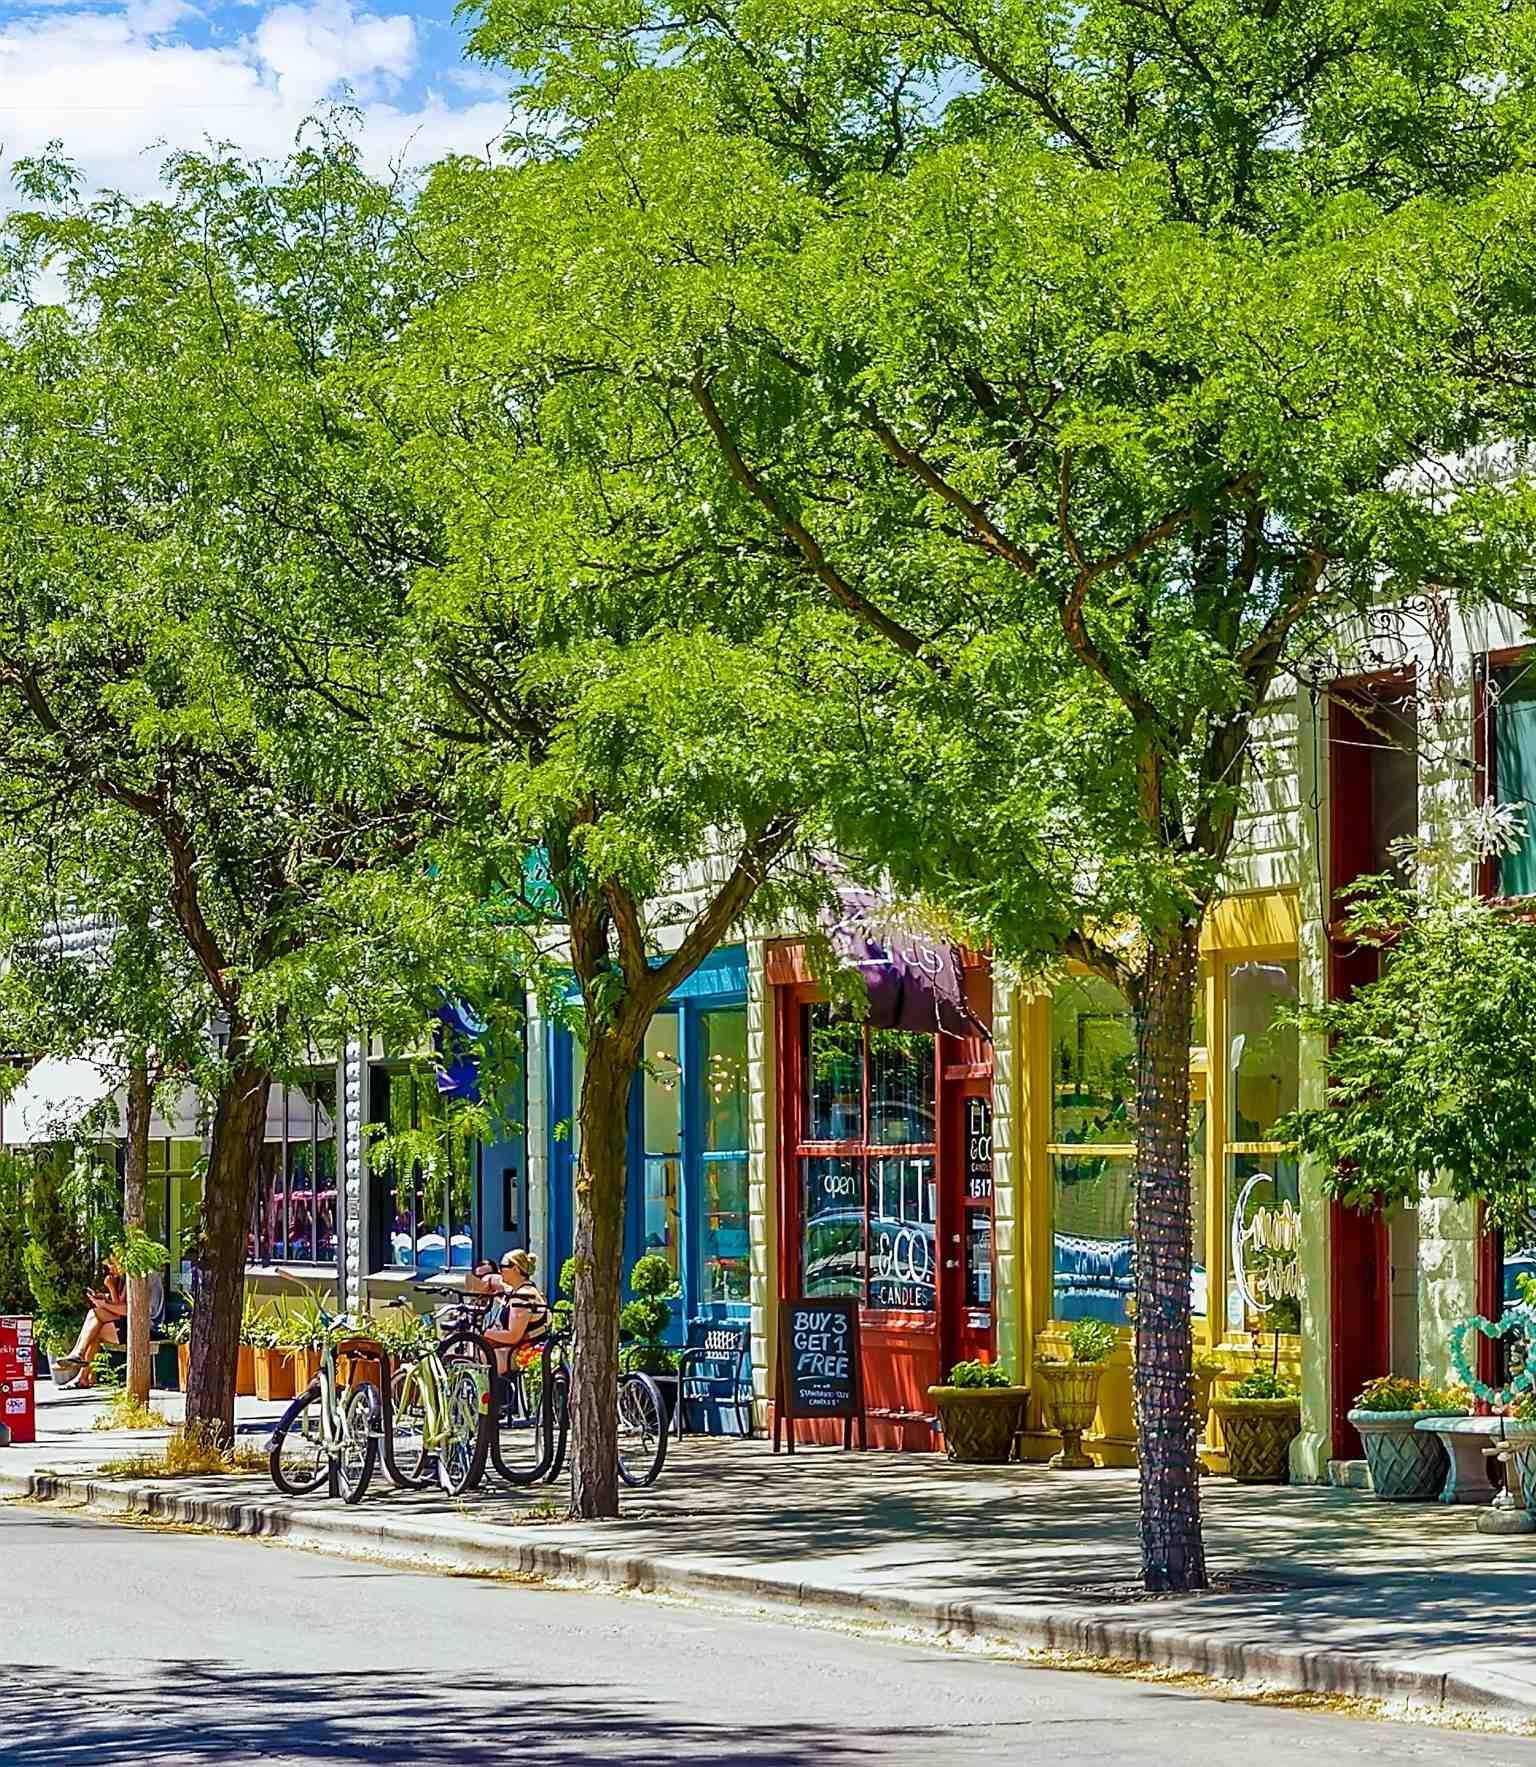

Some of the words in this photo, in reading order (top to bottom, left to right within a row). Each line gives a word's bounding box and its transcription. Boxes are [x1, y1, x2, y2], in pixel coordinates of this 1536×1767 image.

[824, 1175, 855, 1198] open
[879, 1160, 930, 1224] LIT
[969, 1178, 992, 1199] 1517
[880, 1286, 928, 1306] CANDLES
[793, 1311, 832, 1331] BUY
[831, 1313, 848, 1334] 3
[794, 1332, 831, 1351] GET
[833, 1335, 847, 1354] 1
[797, 1353, 849, 1378] FREE
